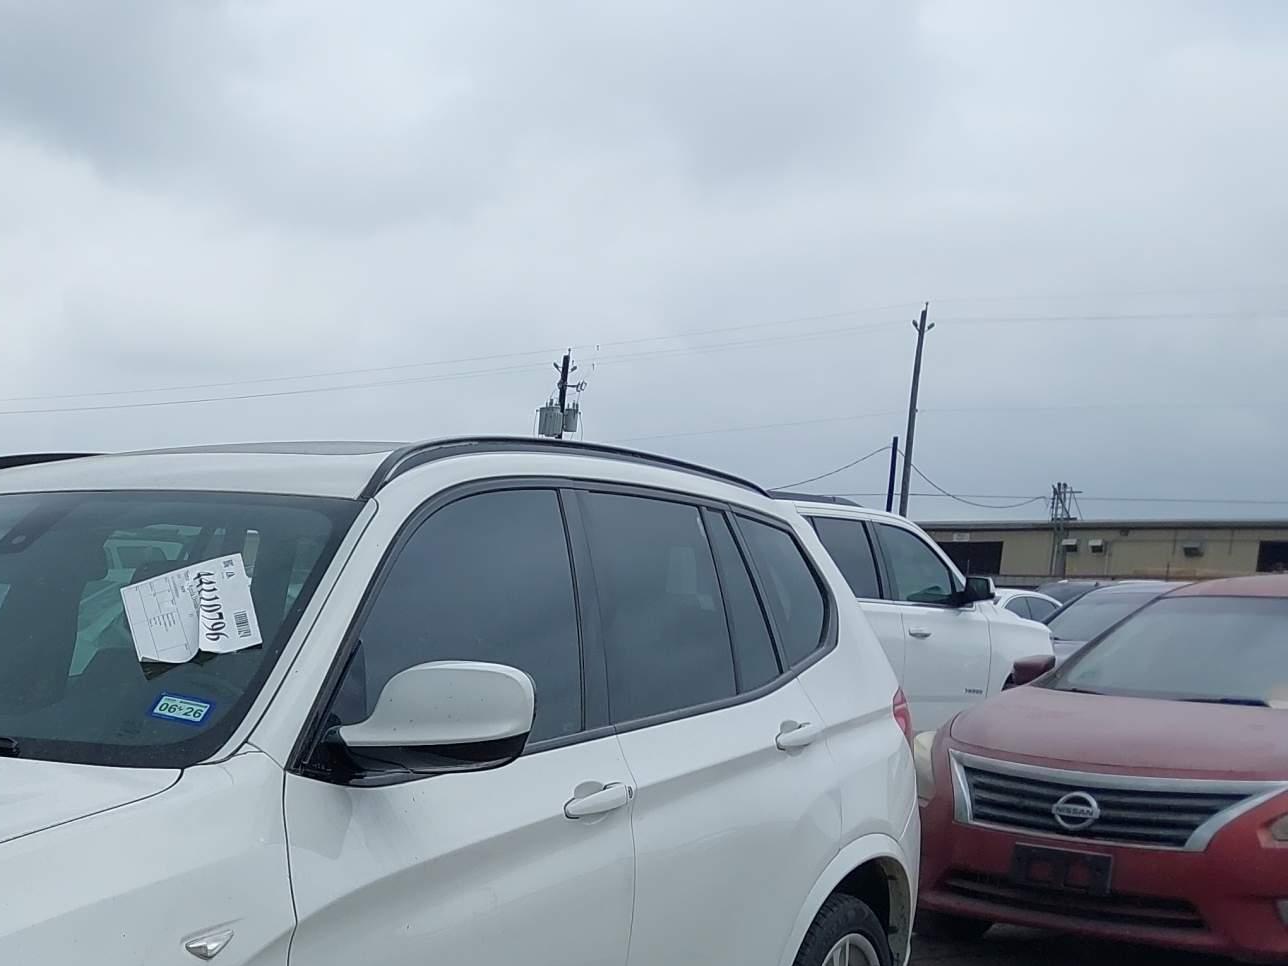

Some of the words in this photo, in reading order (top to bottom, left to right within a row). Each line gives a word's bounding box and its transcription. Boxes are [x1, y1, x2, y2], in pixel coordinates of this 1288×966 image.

[193, 571, 229, 642] 44110796
[158, 702, 178, 714] 06
[182, 706, 204, 719] 26
